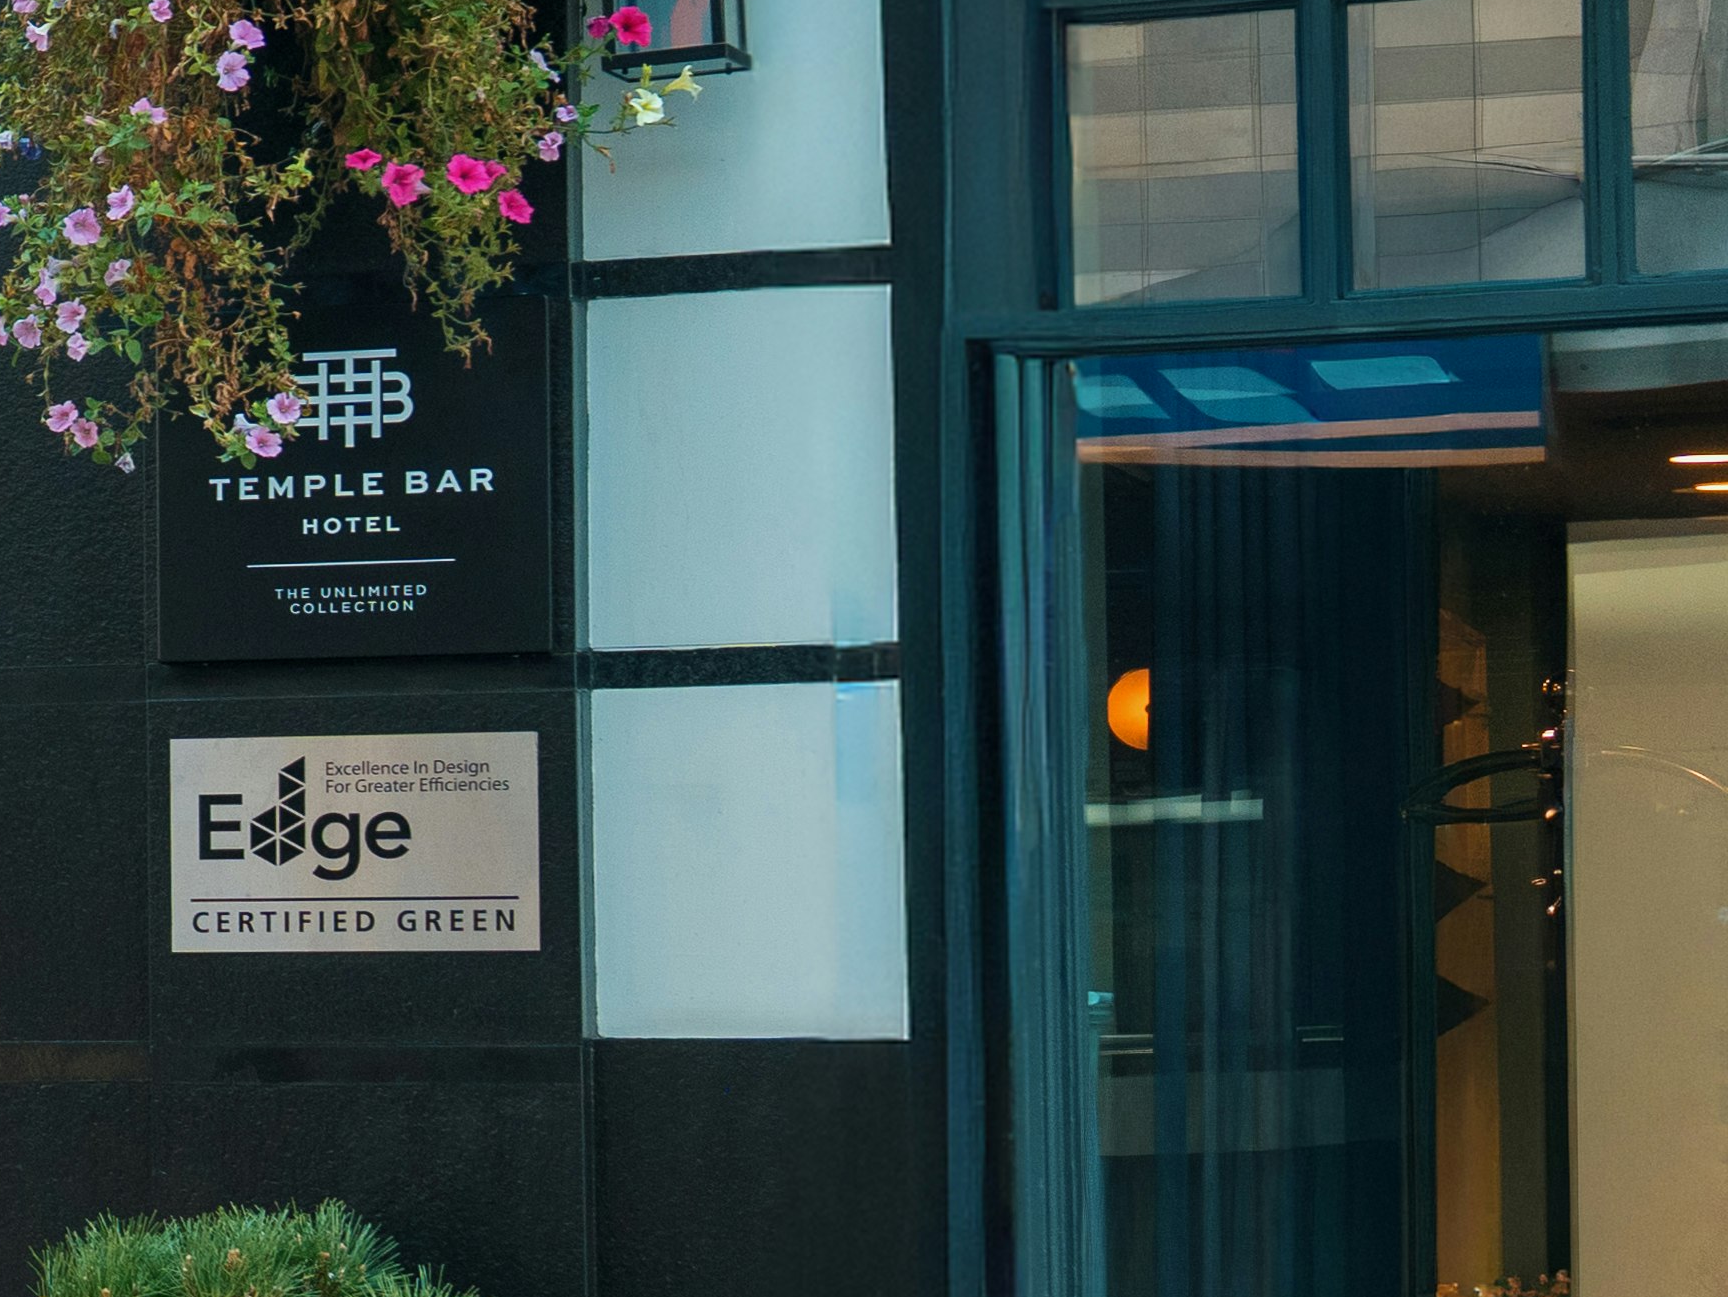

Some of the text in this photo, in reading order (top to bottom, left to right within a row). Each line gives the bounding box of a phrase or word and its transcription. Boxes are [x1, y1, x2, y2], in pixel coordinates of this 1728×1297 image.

[208, 468, 494, 501] TEMPLE BAR
[302, 515, 401, 535] HOTEL
[274, 584, 428, 600] THE UNLIMITED
[289, 599, 415, 614] COLLECTION
[325, 759, 490, 778] Excellence In Design
[325, 777, 511, 794] For Greater Efficiencies
[198, 755, 412, 881] Edge
[192, 908, 516, 934] CERTIFIED GREEN
